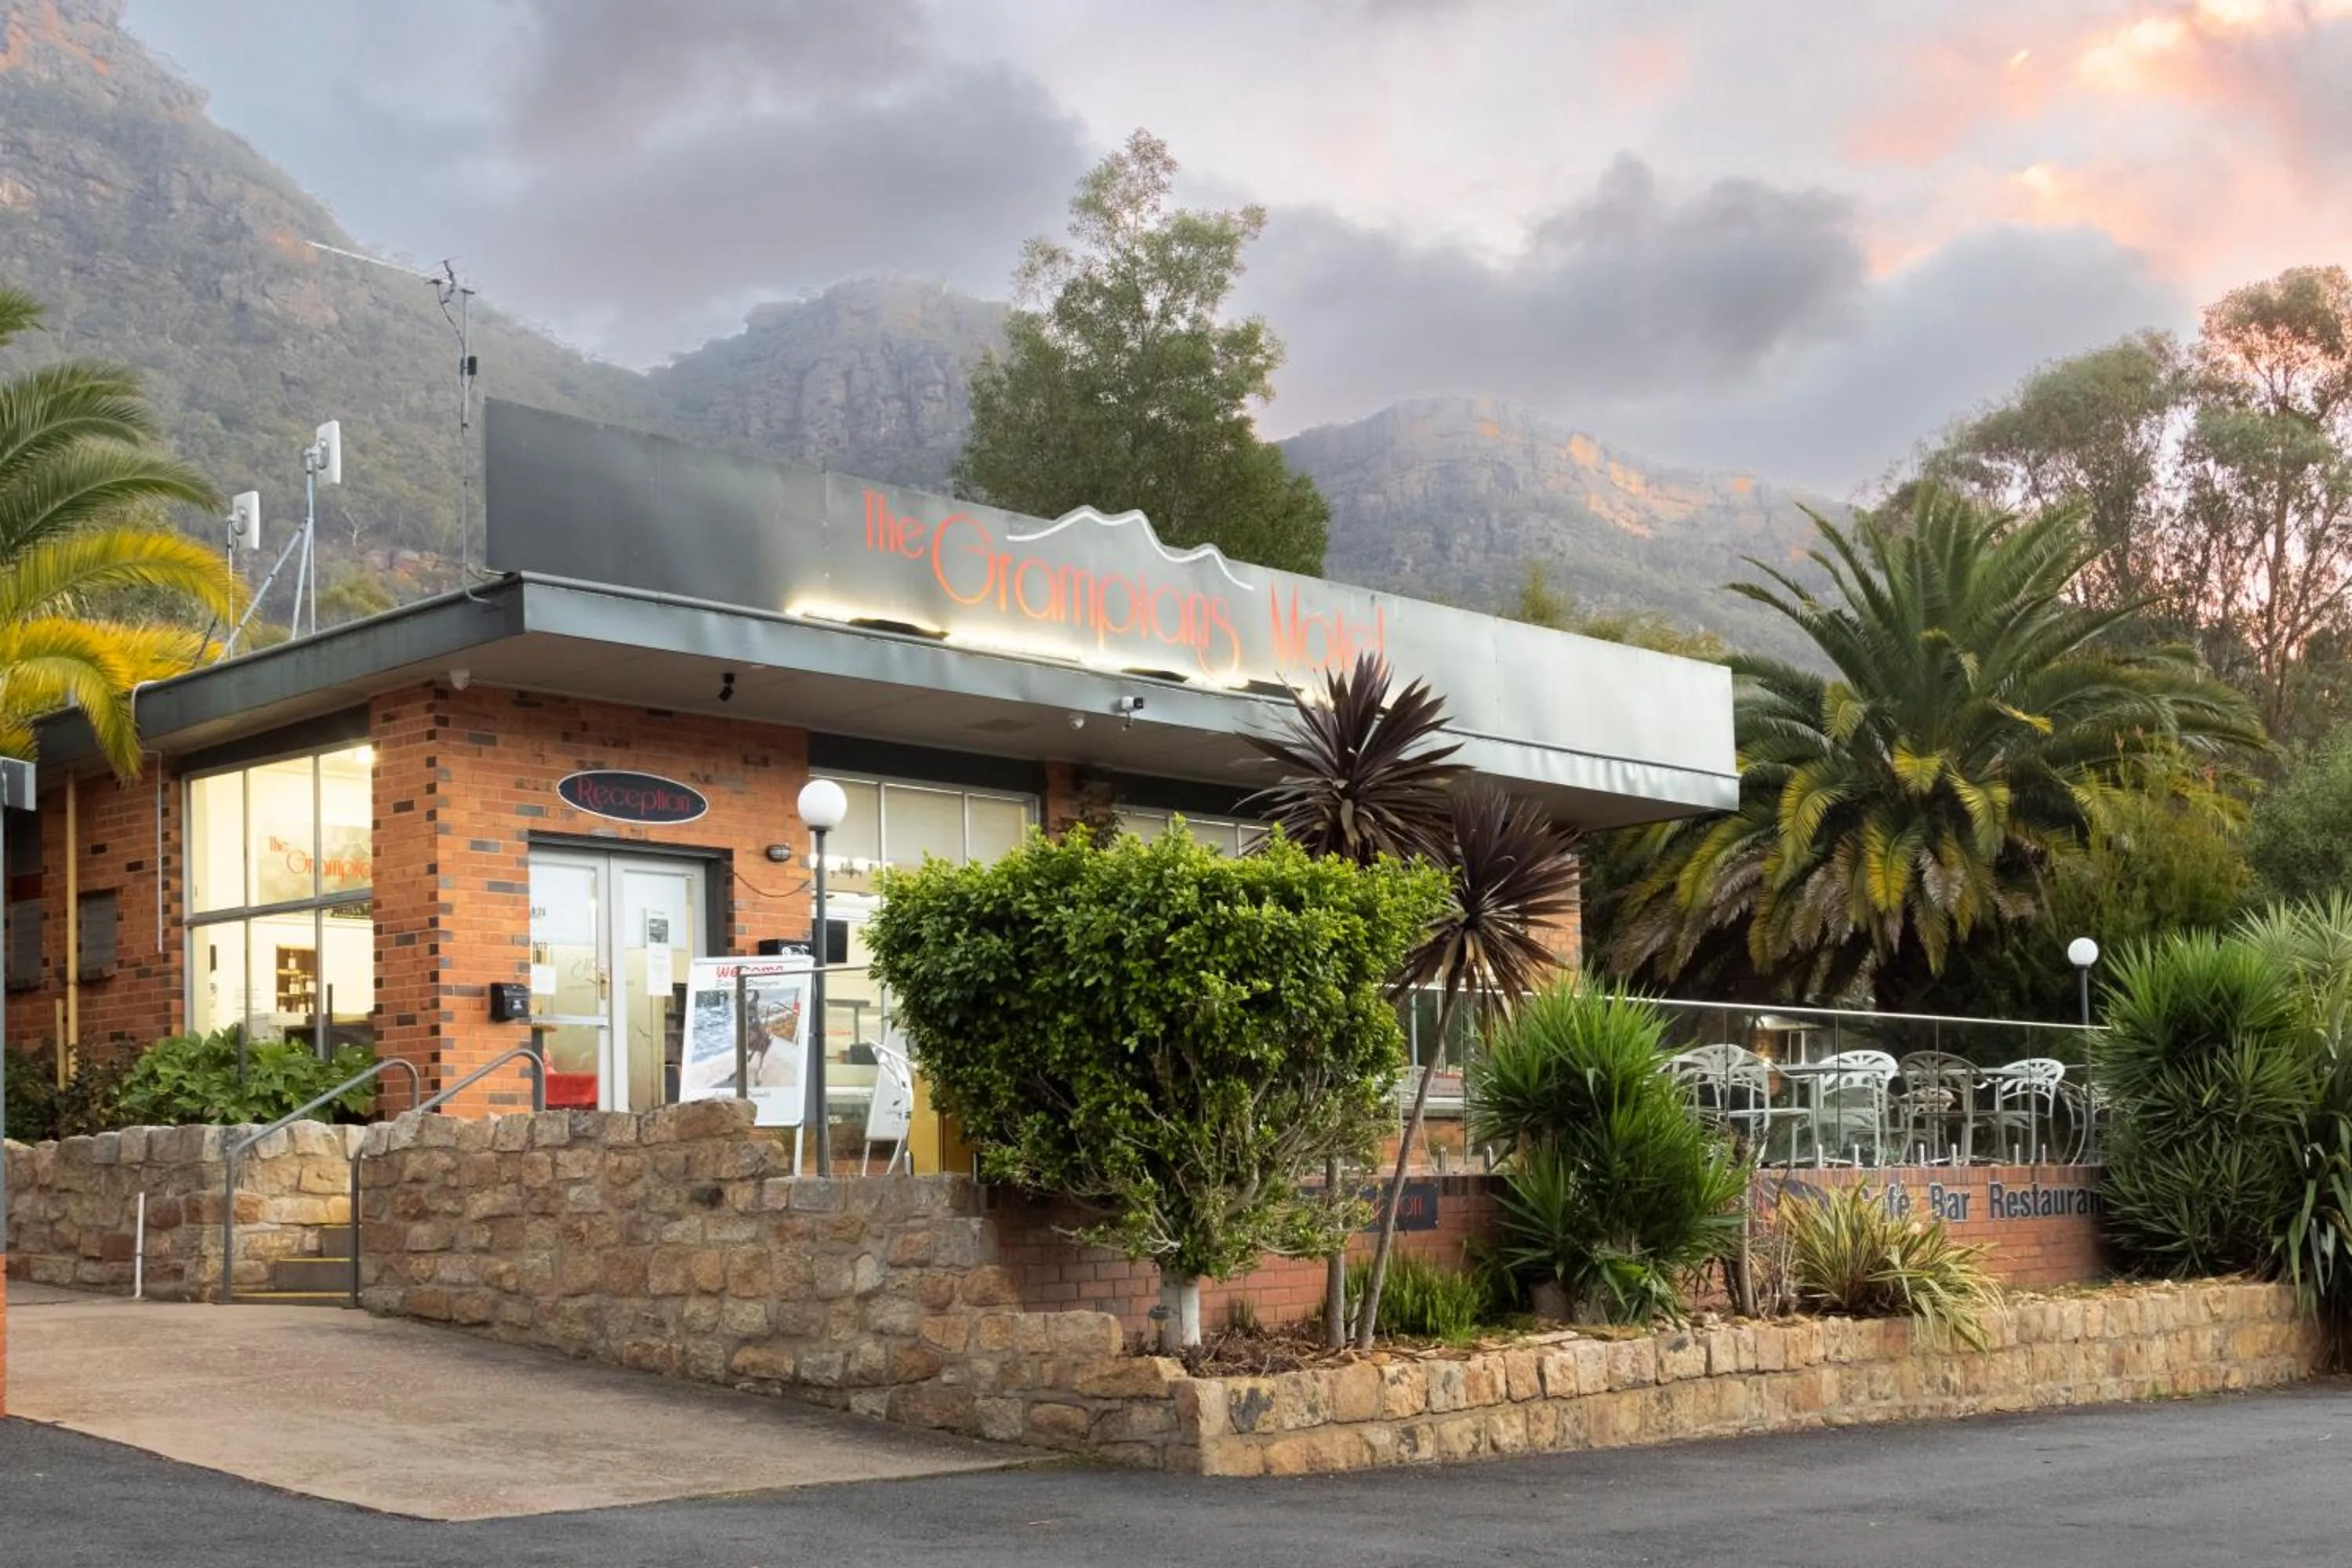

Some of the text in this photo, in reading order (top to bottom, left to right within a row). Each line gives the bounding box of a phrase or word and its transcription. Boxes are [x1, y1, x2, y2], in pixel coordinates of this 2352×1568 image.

[863, 488, 1386, 681] The Grampians Motel
[575, 775, 691, 816] Reception
[1928, 1181, 1971, 1222] Bar
[1988, 1181, 2107, 1220] Restauran
